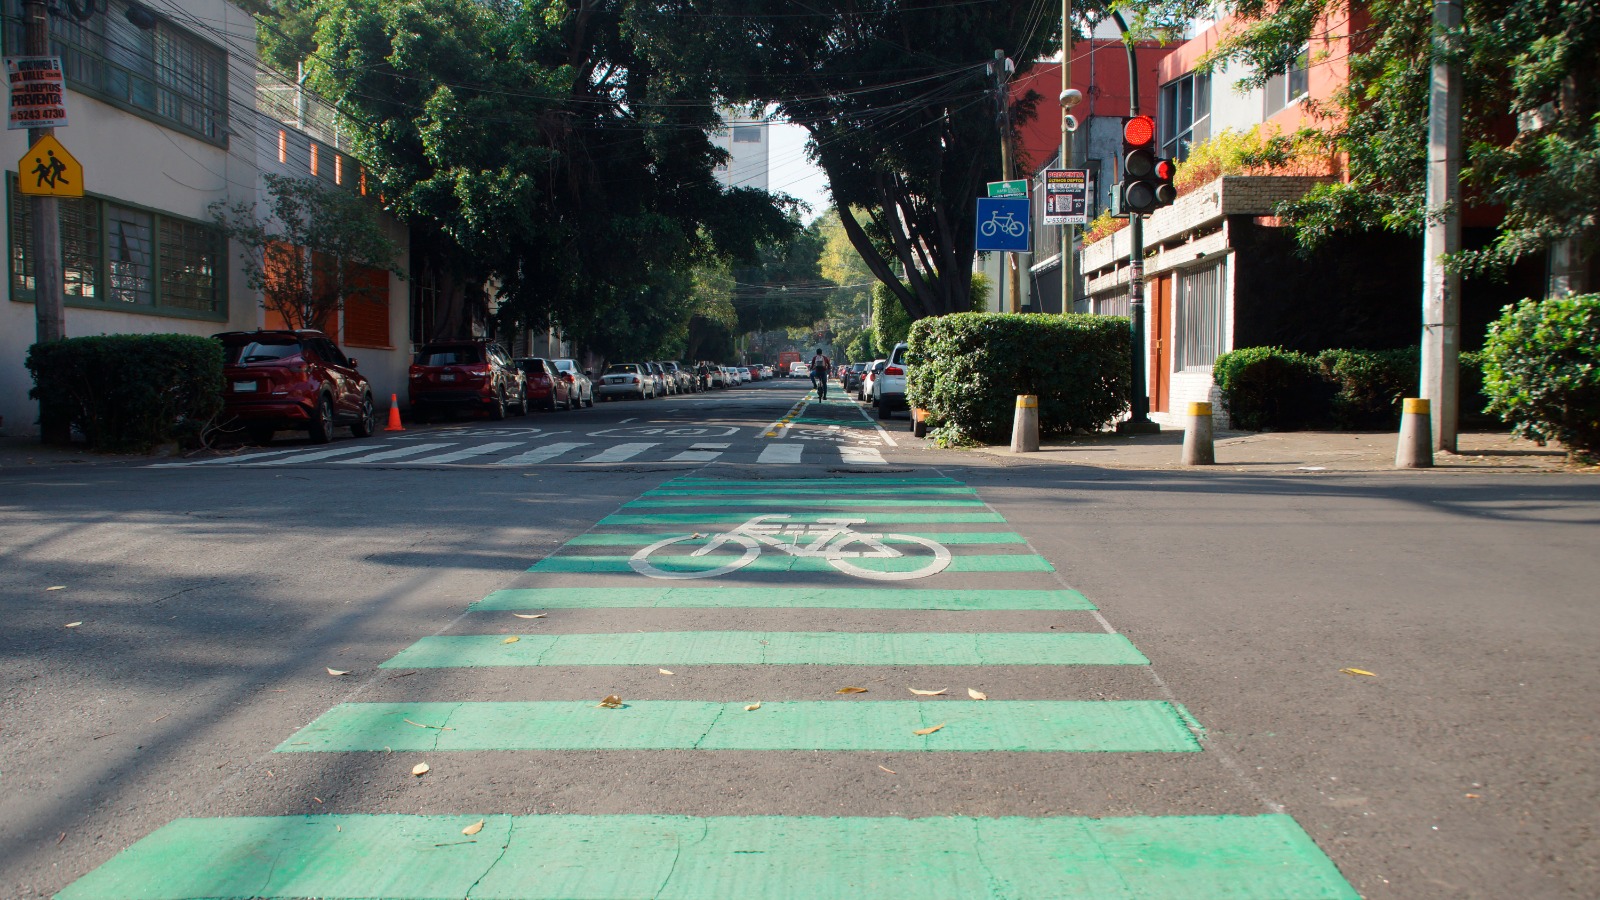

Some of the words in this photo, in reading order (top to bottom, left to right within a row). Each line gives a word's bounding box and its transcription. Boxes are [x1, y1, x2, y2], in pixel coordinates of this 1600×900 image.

[9, 73, 21, 82] DEL
[22, 71, 44, 80] VALLE
[31, 83, 61, 92] DEPTOS
[12, 93, 62, 106] PREVENTA
[17, 109, 40, 120] 5243
[43, 108, 64, 119] 4730
